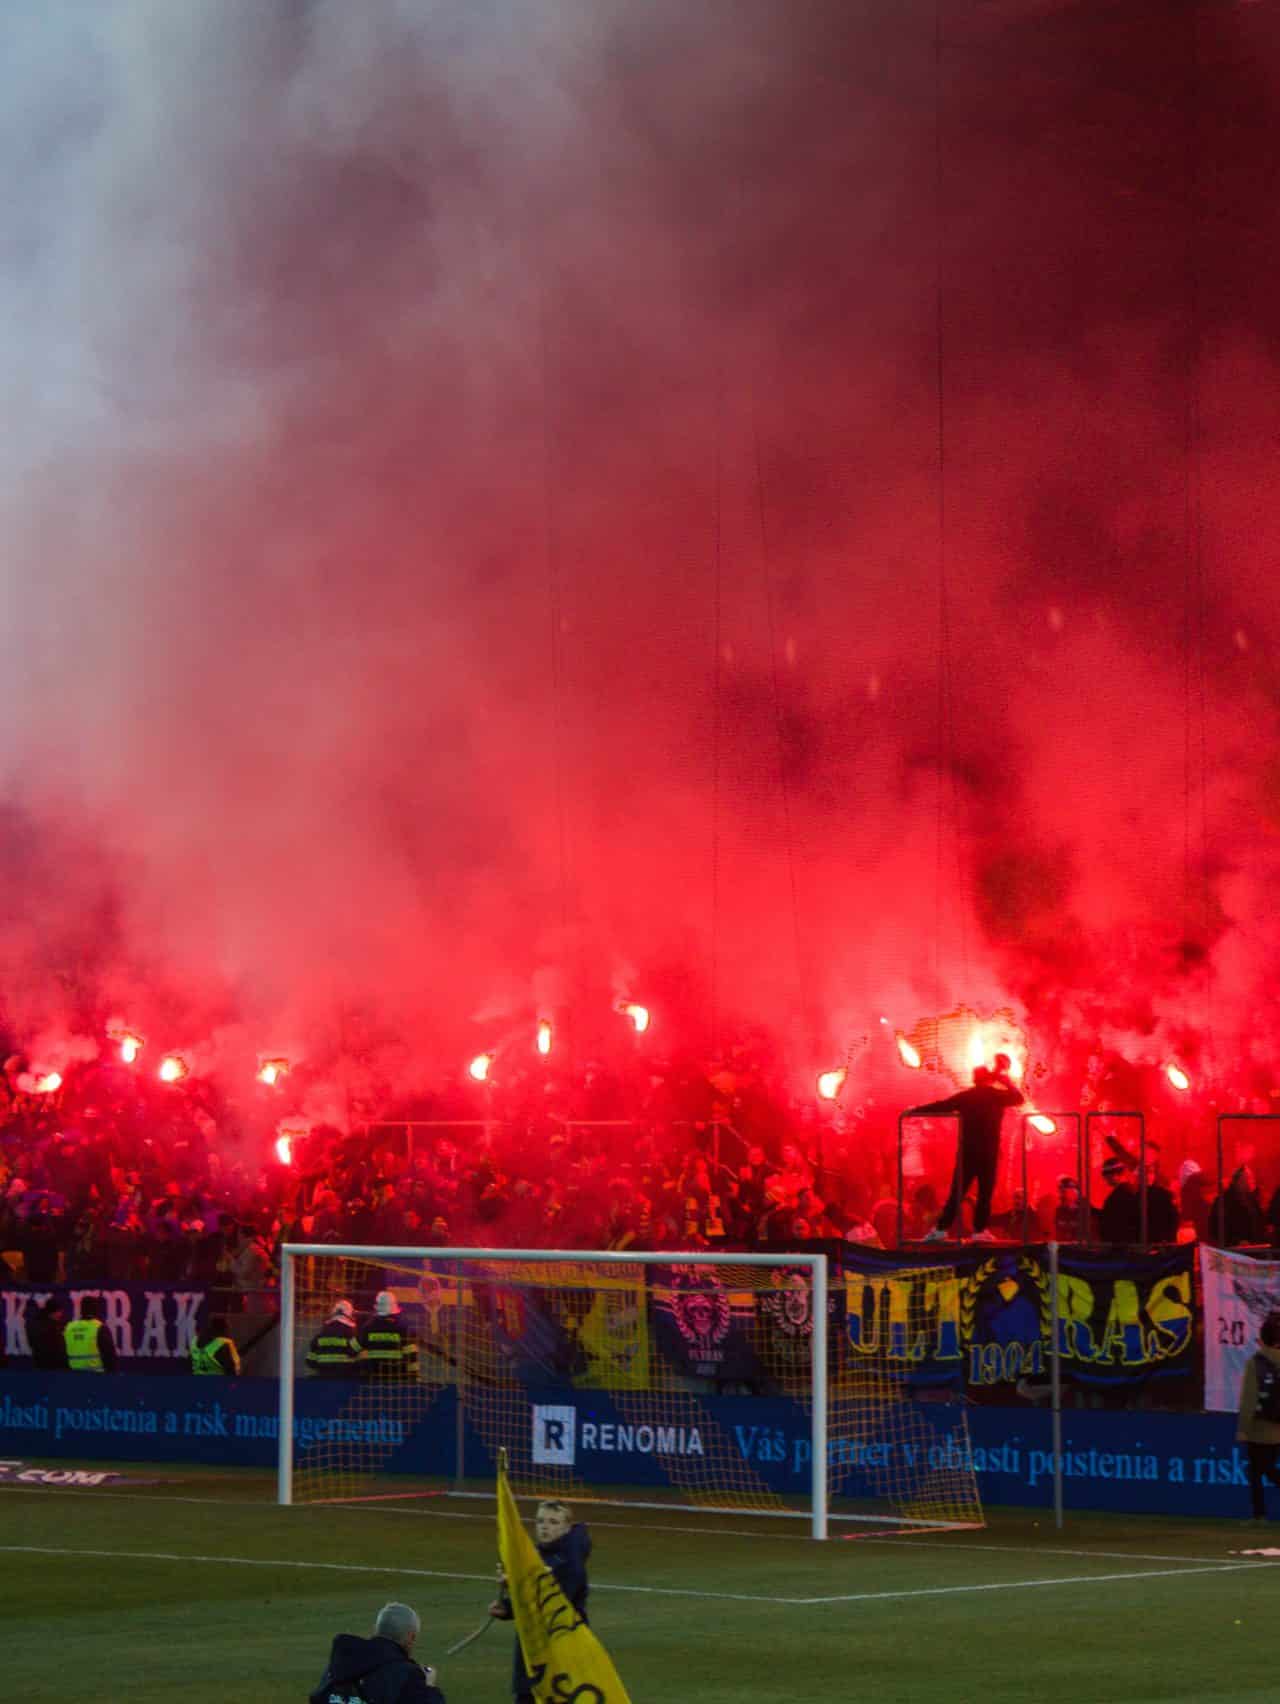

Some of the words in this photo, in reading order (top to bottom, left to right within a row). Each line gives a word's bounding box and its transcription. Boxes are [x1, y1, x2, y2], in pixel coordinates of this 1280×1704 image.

[968, 1341, 1045, 1384] 1904
[0, 1393, 48, 1428] lasti
[54, 1400, 157, 1440] poistenia
[163, 1413, 178, 1434] a
[184, 1401, 228, 1438] risk
[582, 1423, 704, 1456] RENOMIA
[734, 1425, 786, 1462] Váš
[792, 1437, 892, 1473] prtner
[900, 1443, 920, 1467] v
[927, 1433, 1020, 1475] oblasti
[1028, 1438, 1159, 1484] poistenia
[1168, 1457, 1185, 1482] a
[1193, 1448, 1249, 1486] risk
